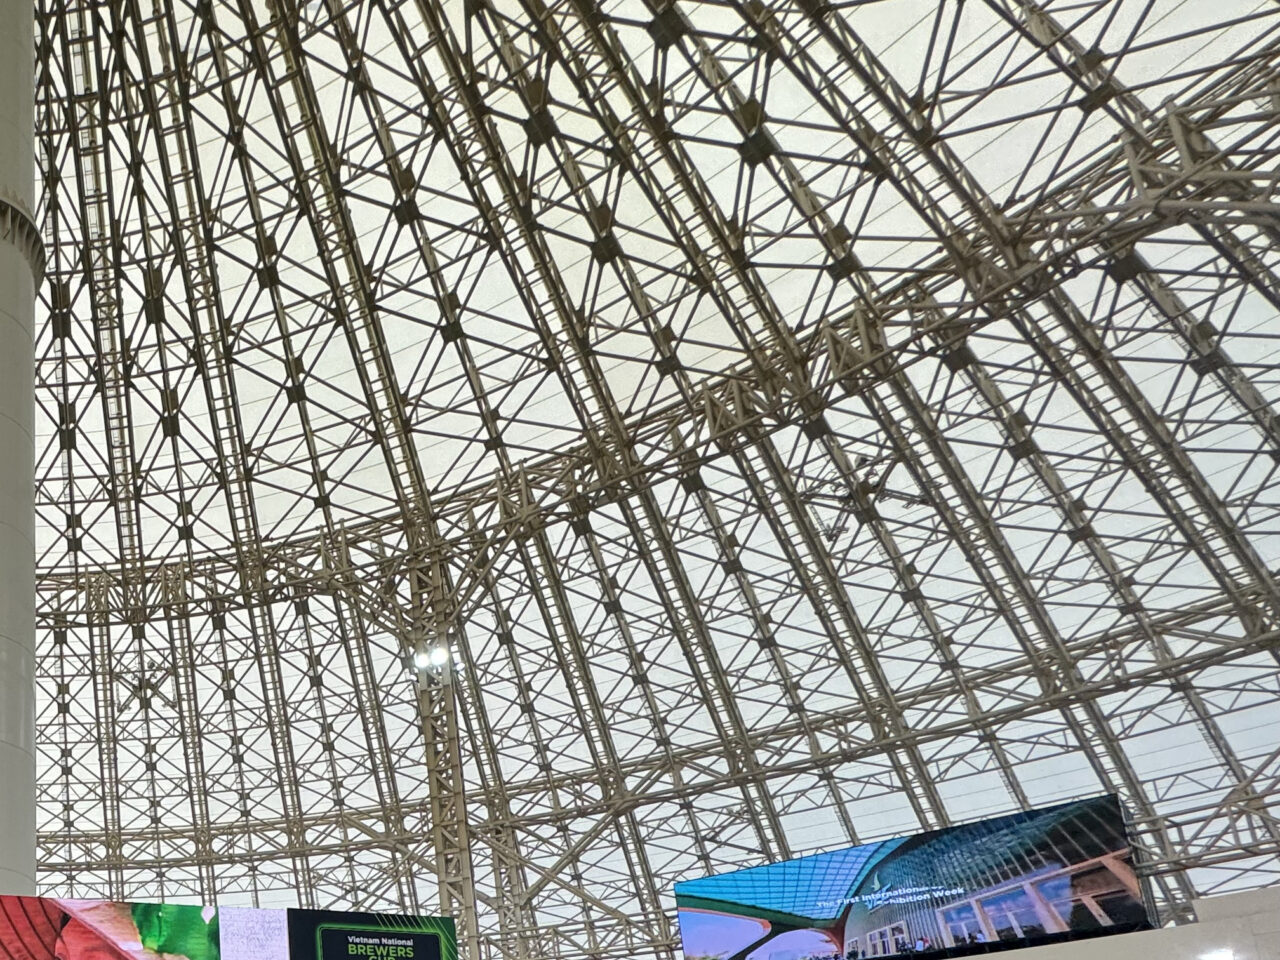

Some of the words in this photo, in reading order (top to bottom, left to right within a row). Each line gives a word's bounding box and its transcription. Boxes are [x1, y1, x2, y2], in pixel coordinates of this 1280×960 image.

[933, 888, 964, 898] Week
[838, 897, 859, 906] First
[348, 936, 380, 944] Vietnam
[382, 938, 413, 946] National
[348, 944, 414, 958] BREWERS
